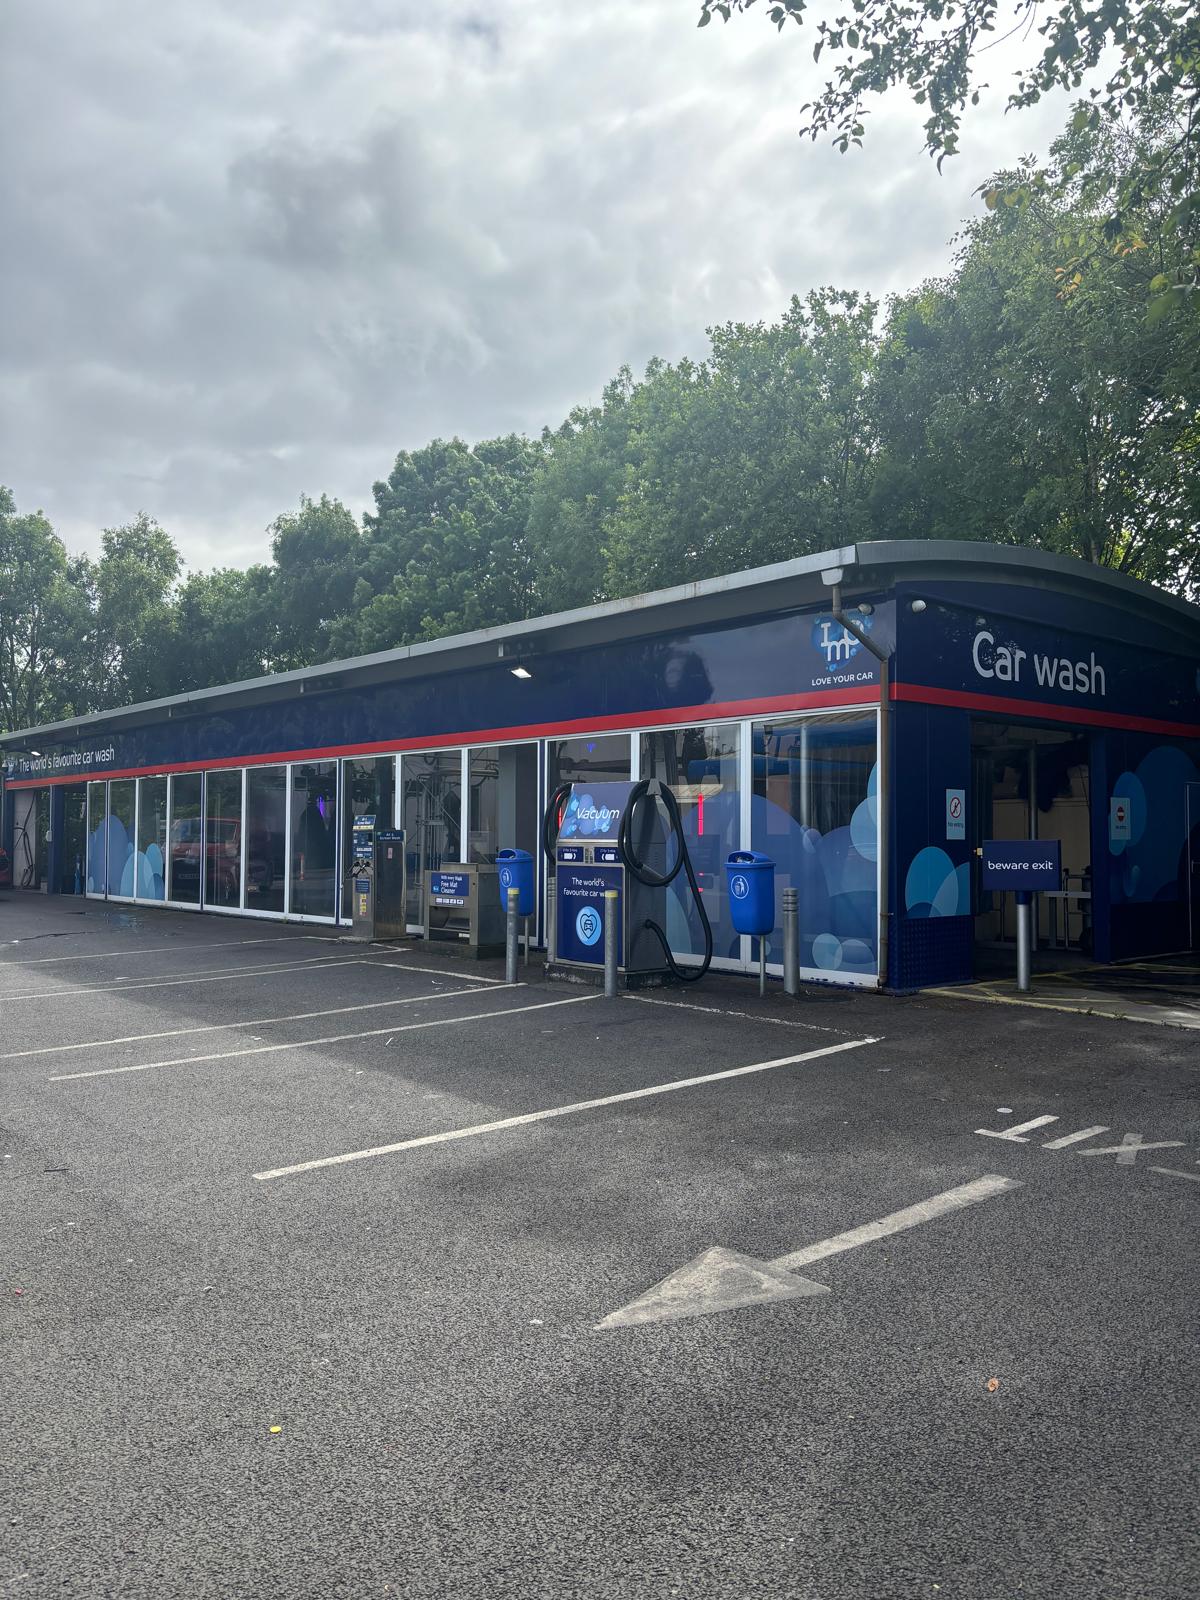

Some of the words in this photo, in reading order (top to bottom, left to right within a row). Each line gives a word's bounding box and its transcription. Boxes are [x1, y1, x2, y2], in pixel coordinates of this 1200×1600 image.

[972, 630, 1027, 682] Car
[1033, 651, 1106, 696] wash
[811, 676, 832, 686] LOVE
[832, 673, 855, 683] YOUR
[856, 671, 873, 681] CAR
[19, 757, 30, 772] The
[30, 753, 52, 771] world's
[52, 750, 82, 768] favourite
[82, 752, 94, 764] car
[94, 744, 115, 763] wash
[576, 807, 620, 819] Vacuum
[987, 860, 1030, 870] beware
[1031, 860, 1054, 870] exit
[571, 876, 583, 886] The
[583, 877, 605, 887] world's
[563, 887, 589, 897] favourite
